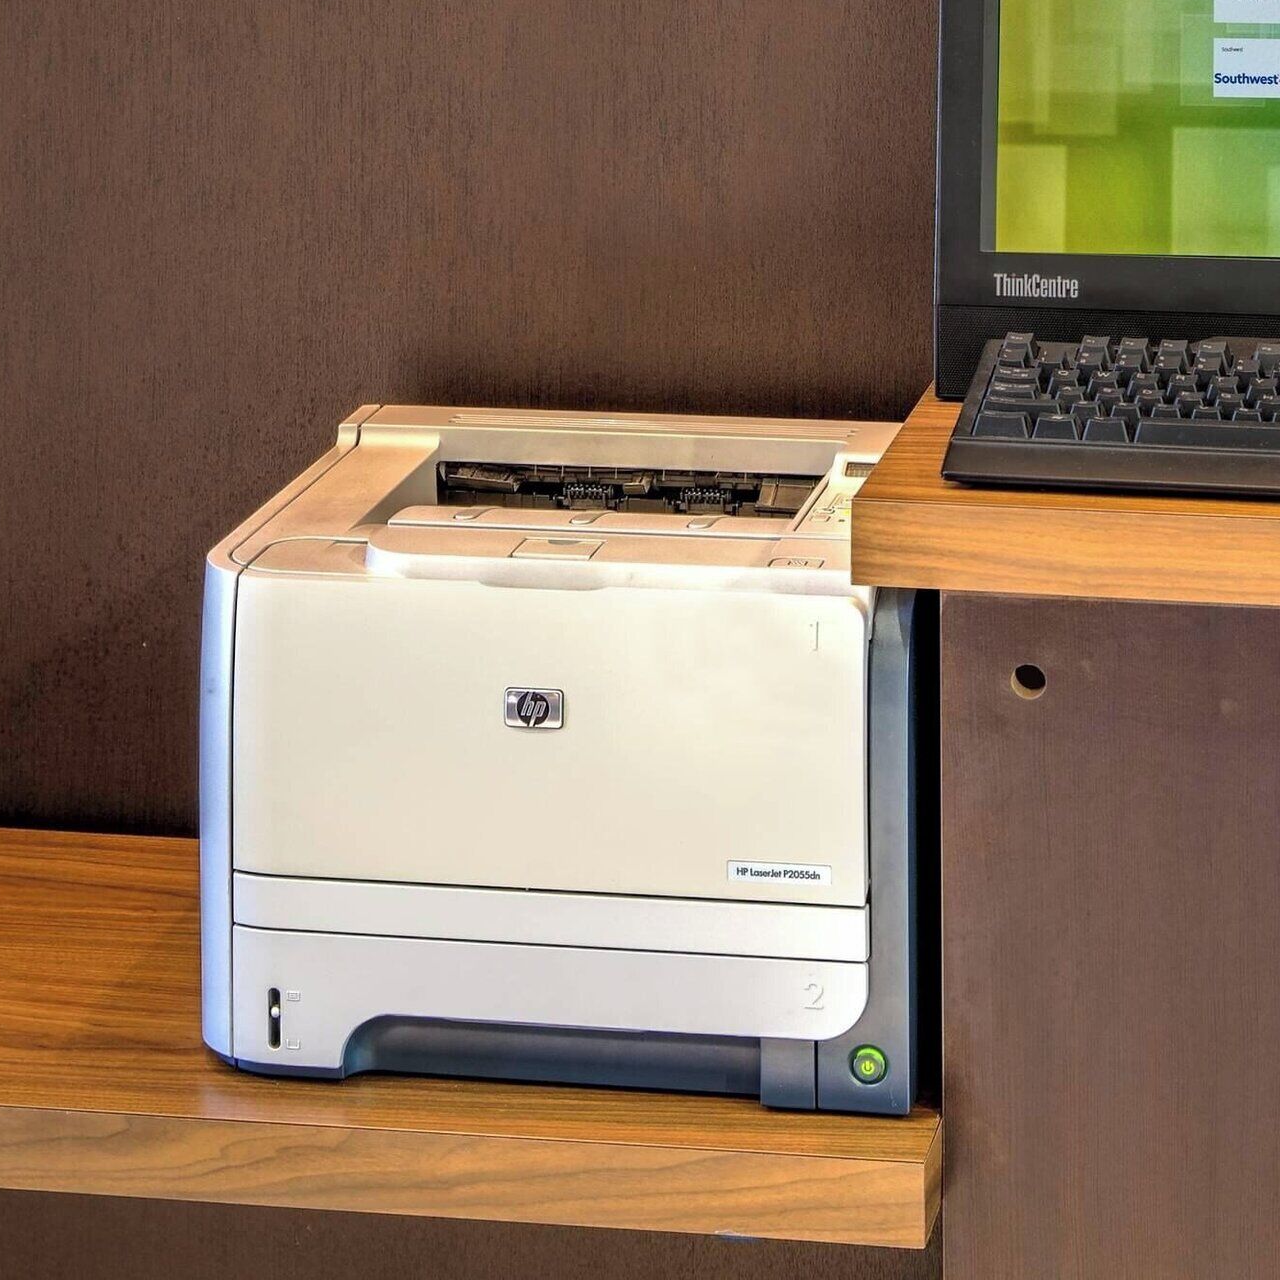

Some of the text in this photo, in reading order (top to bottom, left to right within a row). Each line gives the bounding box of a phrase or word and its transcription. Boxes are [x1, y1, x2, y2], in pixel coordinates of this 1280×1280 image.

[1214, 72, 1279, 85] Southwest
[993, 272, 1079, 299] ThinkCentre
[736, 866, 821, 880] HP LaserJet P2055dn
